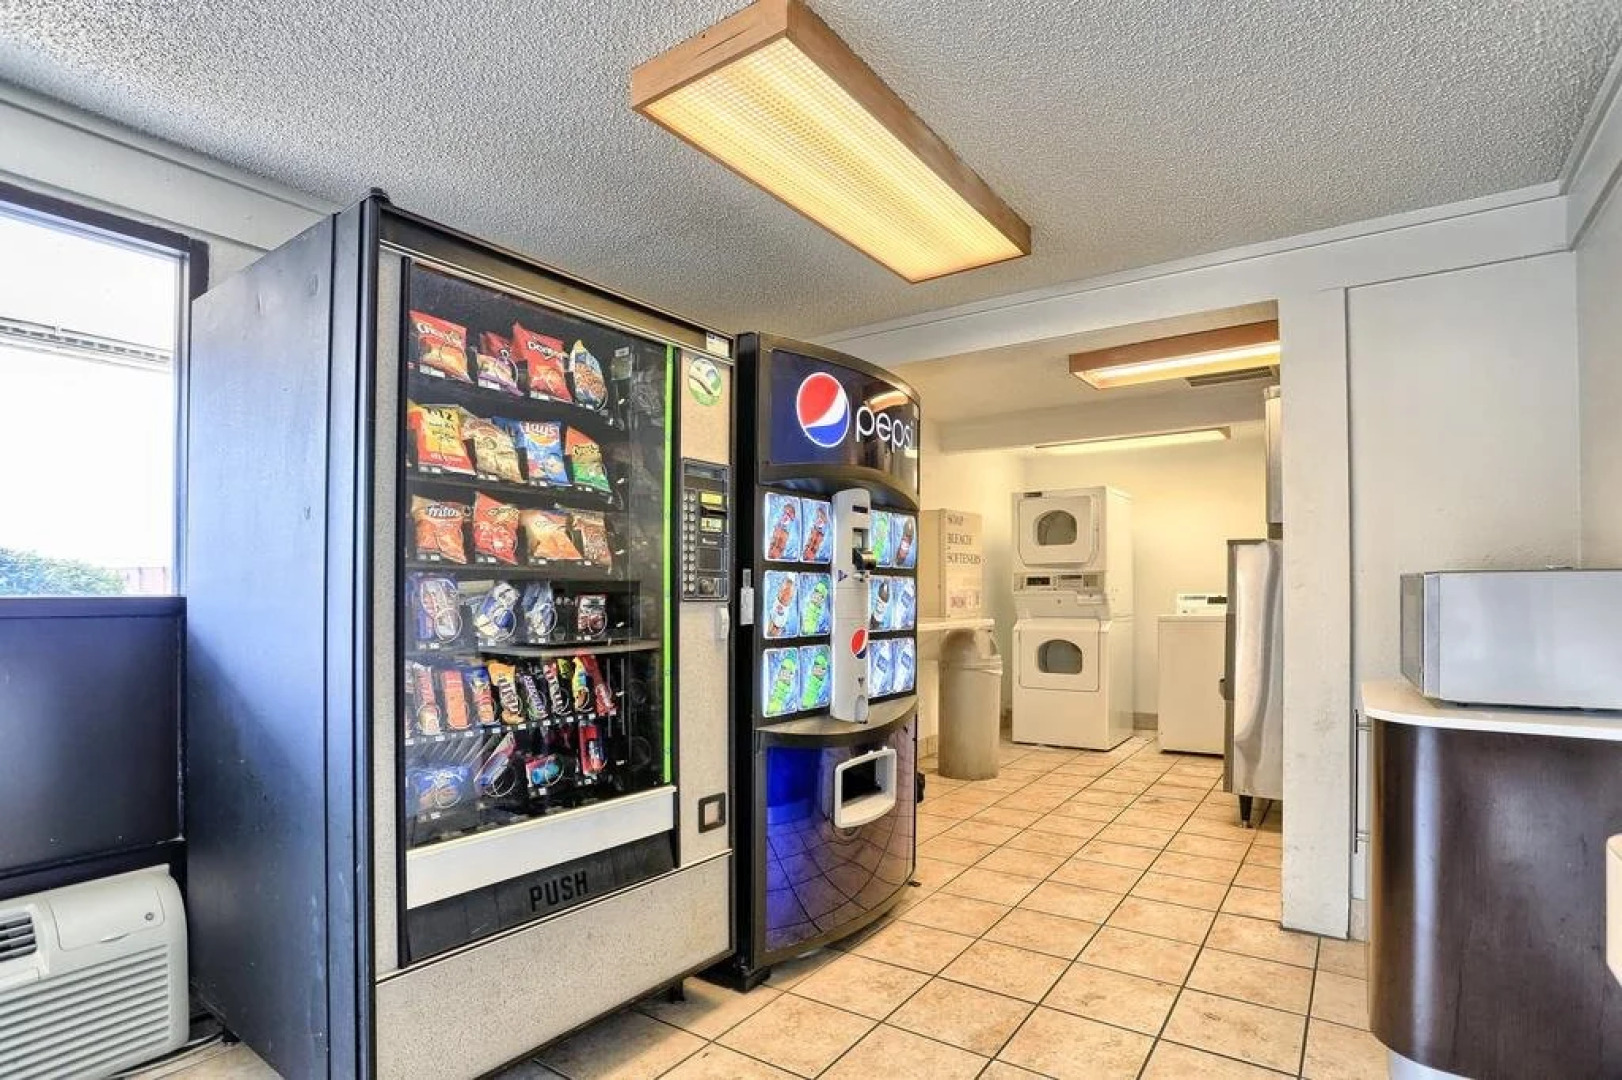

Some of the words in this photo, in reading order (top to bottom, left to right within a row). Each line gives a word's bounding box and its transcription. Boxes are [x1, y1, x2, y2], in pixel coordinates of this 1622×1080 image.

[856, 406, 914, 453] pepsi
[947, 533, 972, 545] BLEACH
[947, 552, 981, 565] SOFTENERS
[529, 870, 588, 912] PUSH
